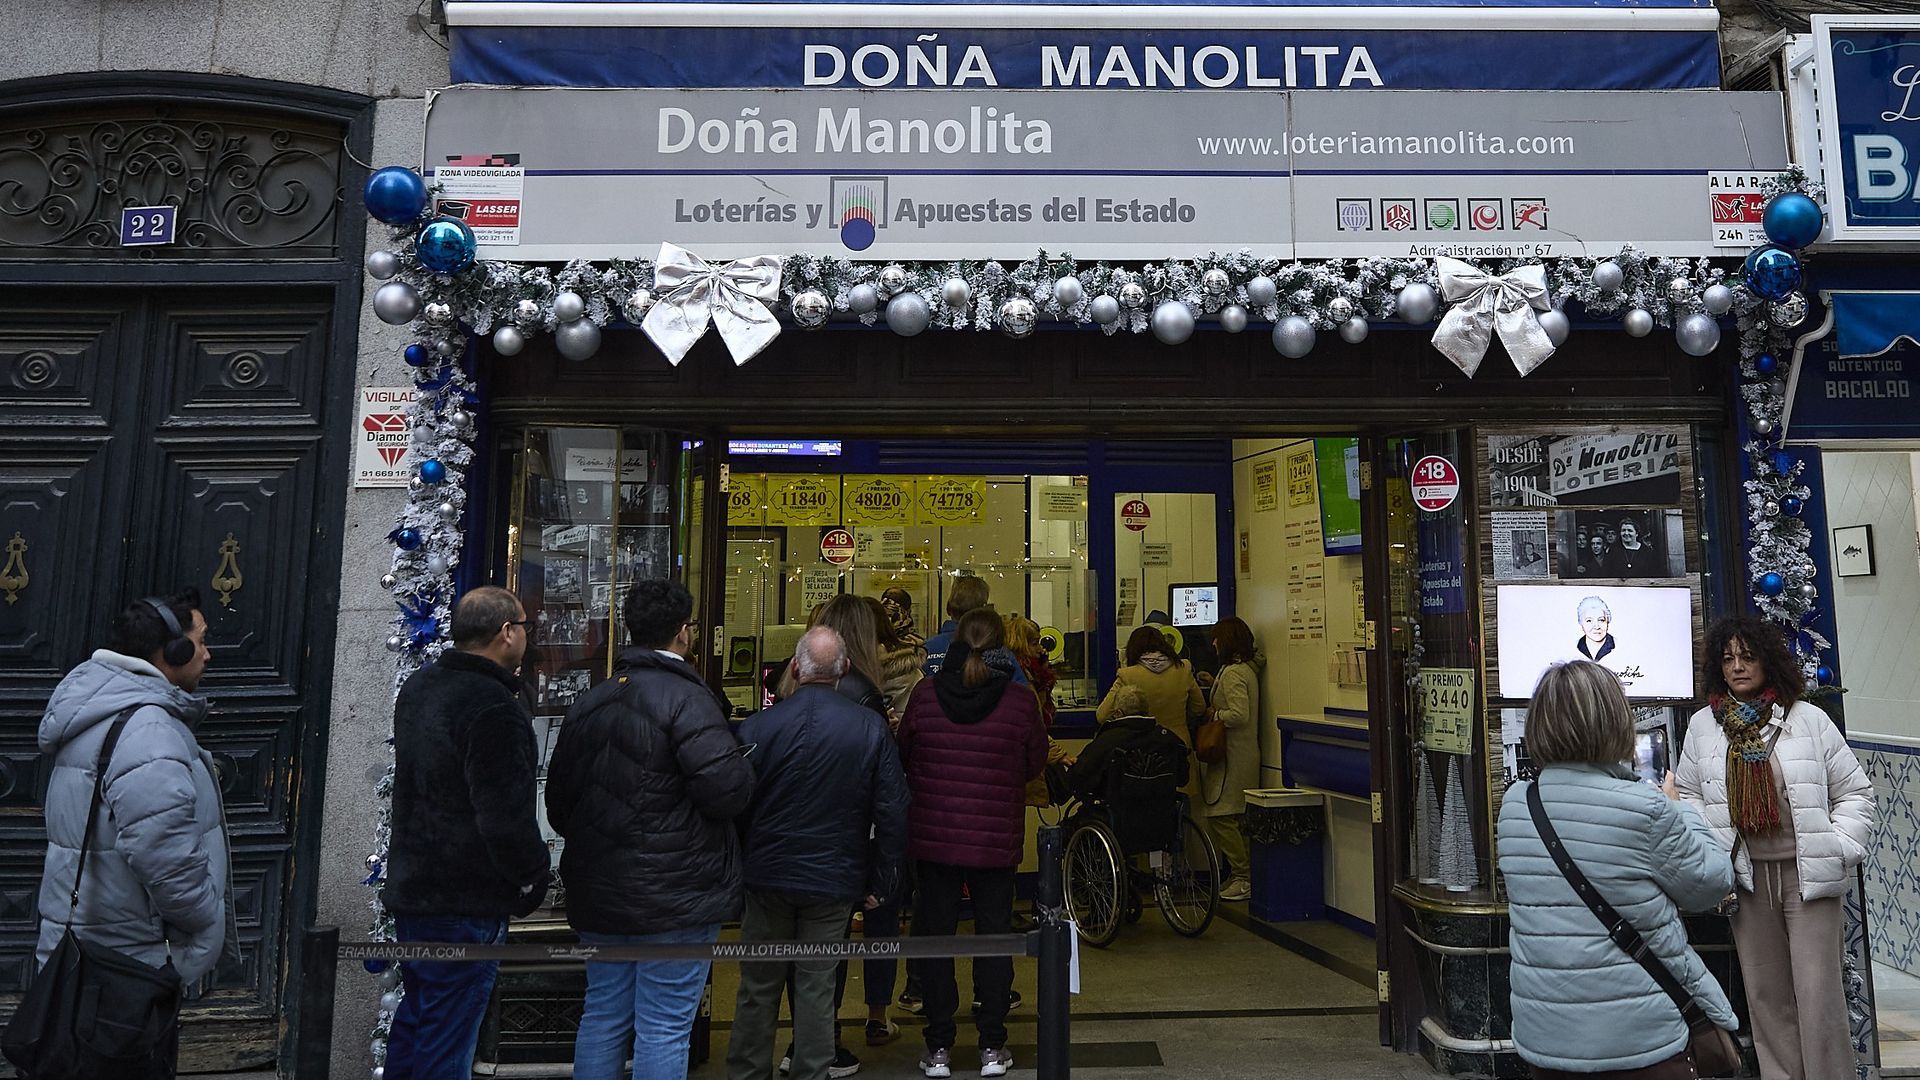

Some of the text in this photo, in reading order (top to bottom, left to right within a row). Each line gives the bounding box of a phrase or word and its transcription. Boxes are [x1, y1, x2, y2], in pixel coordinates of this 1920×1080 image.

[803, 33, 1385, 88] DOÑA MANOLITA
[657, 105, 1052, 155] Doña Manolita
[1198, 131, 1576, 156] www.loteriamanolita.com
[440, 169, 521, 177] ZONA VIDEOVIGILADA
[1853, 134, 1920, 204] B
[1710, 176, 1760, 188] ALAR
[476, 205, 518, 214] LASSER
[675, 196, 1196, 229] Loterías y Apuestas del Estado
[131, 213, 165, 238] 22
[1719, 229, 1743, 240] 24h
[1409, 244, 1512, 257] Administración
[1535, 244, 1552, 256] 67
[1828, 360, 1903, 372] AUTENTICO
[1825, 380, 1911, 399] BACALAO
[365, 391, 417, 403] VIGILAD
[1495, 447, 1543, 464] DESDE
[1420, 461, 1446, 480] +18
[1553, 452, 1680, 493] LOTERIA
[1504, 475, 1537, 491] 1904
[781, 491, 827, 506] 11840
[855, 493, 901, 507] 48020
[928, 493, 974, 507] 74778
[1126, 503, 1144, 514] +18
[828, 533, 848, 545] +18
[1423, 595, 1444, 607] Estado
[1432, 673, 1463, 687] PREMIO
[337, 946, 467, 959] ERIAMANOLITA.COM
[712, 941, 900, 956] WWW.LOTERIAMANOLITA.COM
